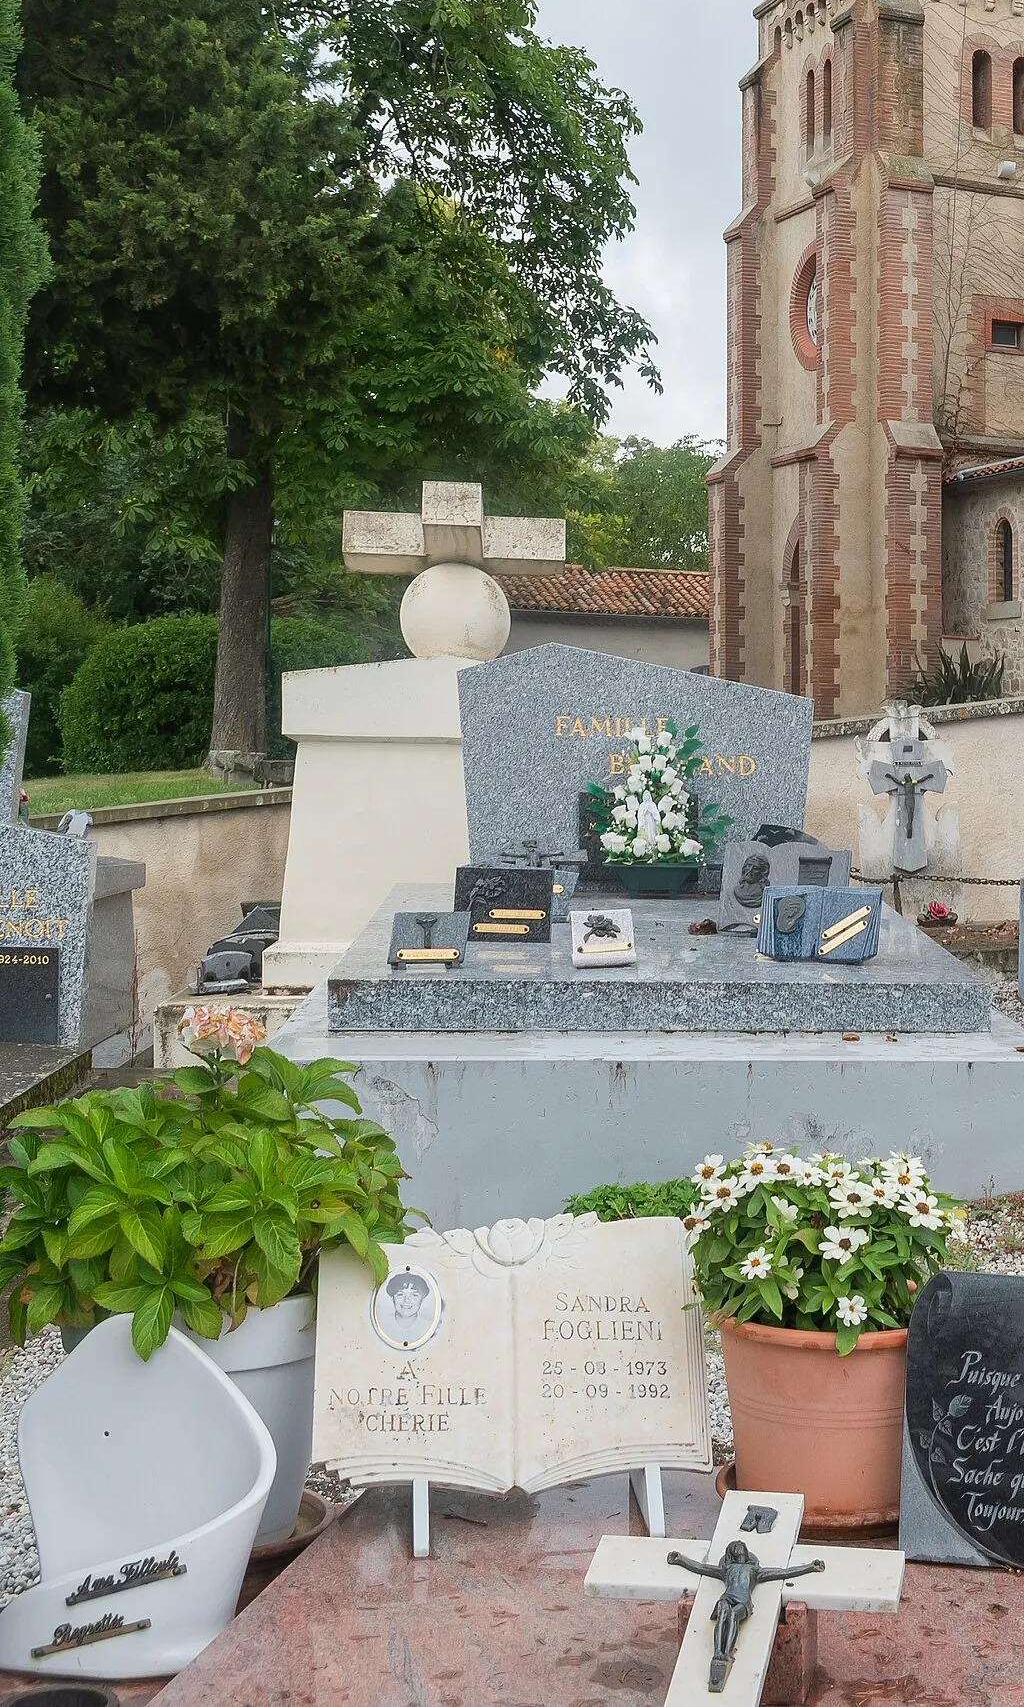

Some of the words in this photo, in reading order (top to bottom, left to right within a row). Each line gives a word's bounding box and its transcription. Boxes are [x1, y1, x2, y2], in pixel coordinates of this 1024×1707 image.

[554, 1292, 651, 1314] SANDRA
[541, 1317, 664, 1342] FOGLIENI
[542, 1360, 563, 1375] 25
[626, 1360, 667, 1376] 1973
[945, 1350, 1020, 1396] Puisque
[328, 1387, 409, 1406] NOTRE
[421, 1384, 488, 1407] FILLE
[542, 1383, 564, 1398] 20
[585, 1383, 608, 1399] 09
[628, 1383, 671, 1399] 1992
[956, 1423, 1002, 1454] C'est
[945, 1455, 1005, 1487] Sache
